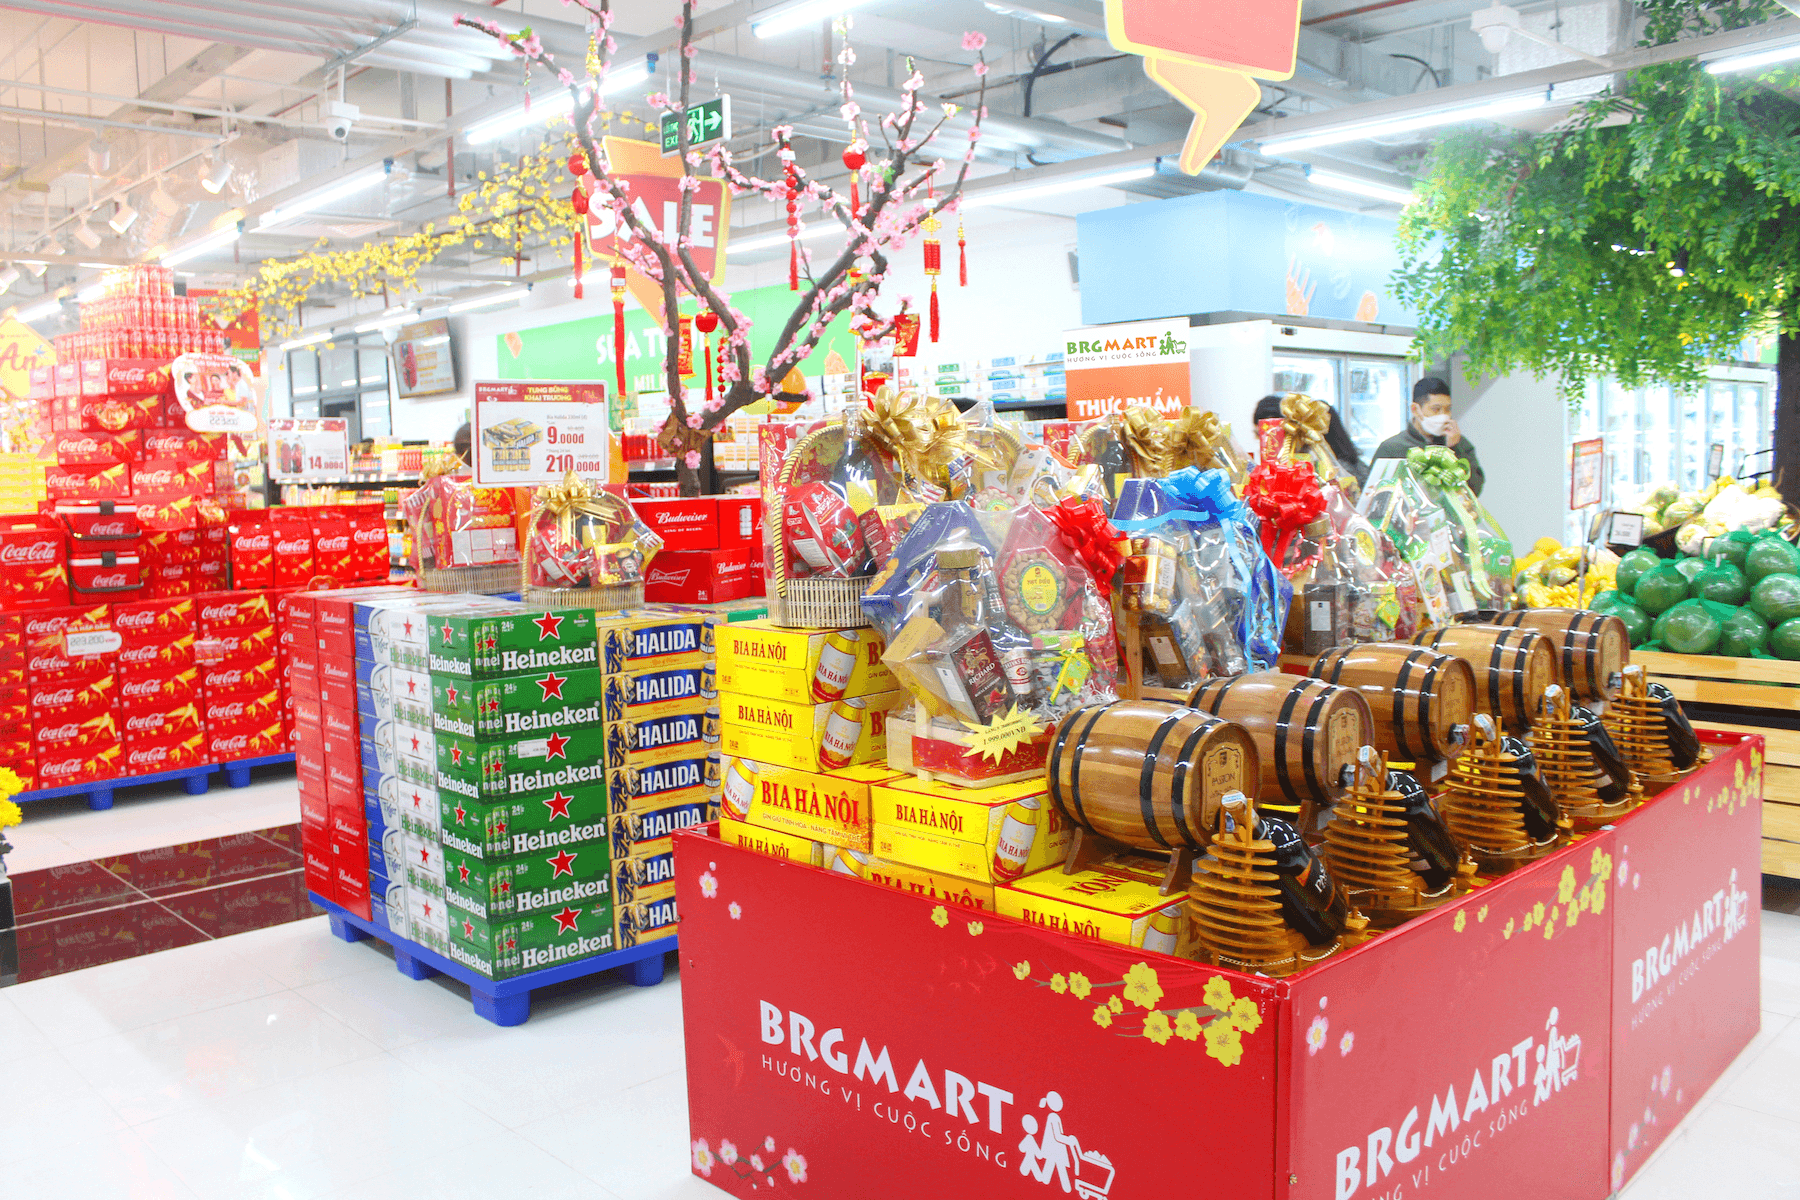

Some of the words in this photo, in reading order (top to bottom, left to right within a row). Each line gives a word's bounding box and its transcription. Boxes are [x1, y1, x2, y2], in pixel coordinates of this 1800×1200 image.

[588, 191, 715, 248] SALE
[1066, 336, 1157, 354] BRGMART
[547, 426, 584, 444] 9.000đ
[655, 512, 708, 524] Budweiser
[651, 570, 686, 581] Budweiser
[636, 628, 696, 655] HALIDA
[733, 640, 750, 657] BIA
[751, 638, 766, 658] HÀ
[768, 641, 787, 663] NỘI
[429, 654, 472, 675] Heineken
[502, 645, 596, 671] Heineken
[636, 674, 696, 702] HALIDA
[968, 662, 996, 685] RICHARD
[434, 713, 475, 737] Heineken
[505, 706, 599, 733] Heineken
[738, 705, 755, 722] BIA
[757, 705, 773, 725] HÀ
[774, 709, 793, 731] NỘI
[638, 719, 698, 748] HALIDA
[437, 771, 479, 799] Heineken
[508, 765, 603, 793] Heineken
[640, 764, 700, 794] HALIDA
[761, 780, 791, 811] BIA
[795, 783, 821, 817] HÀ
[824, 790, 859, 830] NỘI
[896, 804, 917, 824] BIA
[919, 805, 937, 827] HÀ
[940, 810, 963, 834] NỘI
[401, 814, 438, 842] Heineken
[642, 808, 702, 838] HALIDA
[442, 828, 483, 859] Heineken
[512, 822, 606, 854] Heineken
[446, 886, 487, 919] Heineken
[516, 879, 609, 912] Heineken
[450, 942, 493, 976] Heineken
[522, 933, 613, 969] Heineken
[1631, 888, 1724, 1004] BRGMART
[758, 999, 1014, 1134] BRGMART
[762, 1054, 830, 1096] HƯƠNG
[841, 1087, 861, 1112] VỊ
[873, 1103, 931, 1138] CUỘC
[945, 1130, 1007, 1168] SỐNG
[1335, 1036, 1533, 1200] BRGMART
[1412, 1165, 1429, 1189] VỊ
[1438, 1129, 1481, 1171] CUỘC
[1489, 1099, 1527, 1138] SỐNG
